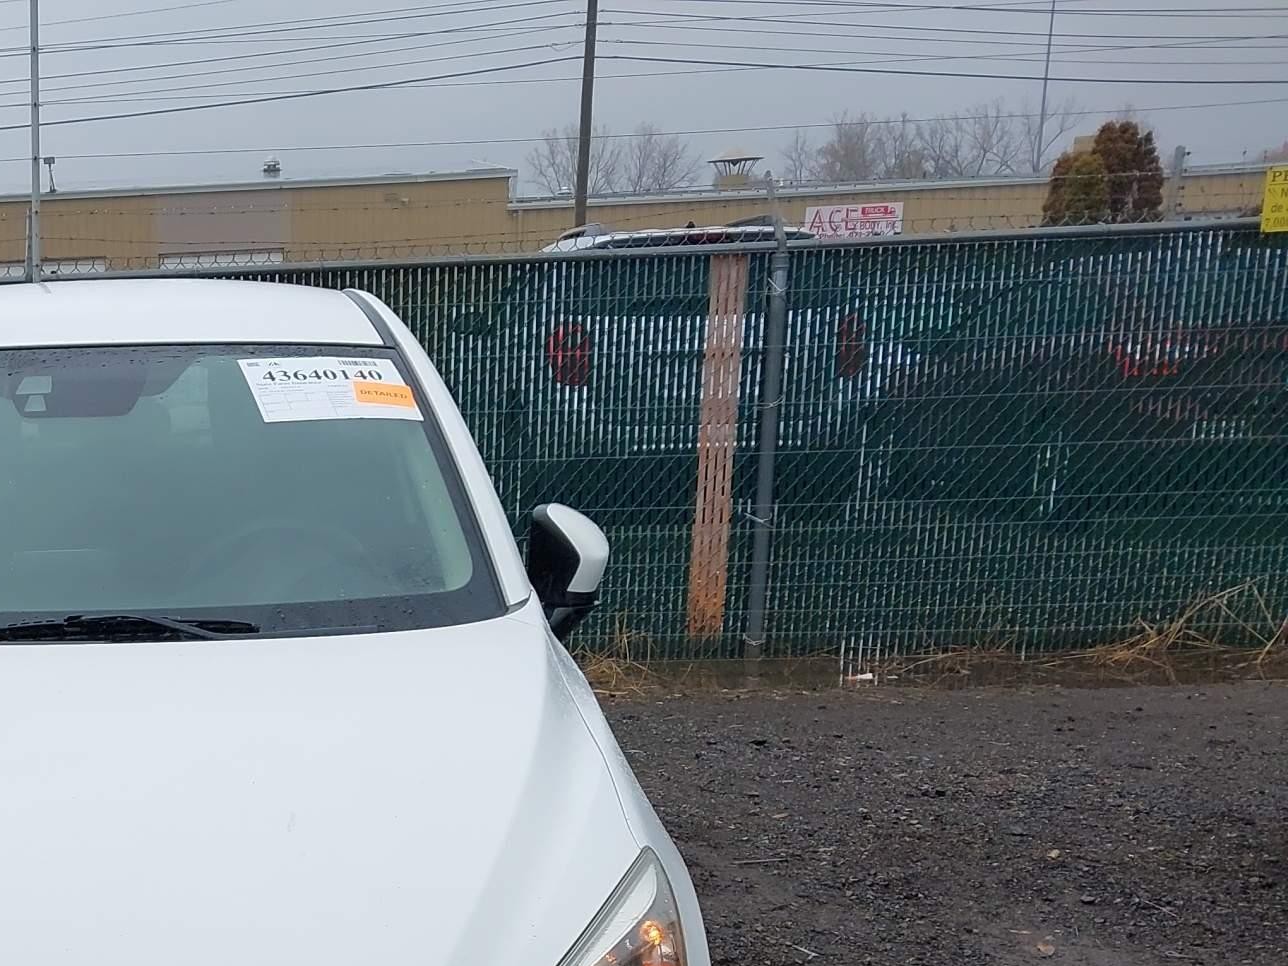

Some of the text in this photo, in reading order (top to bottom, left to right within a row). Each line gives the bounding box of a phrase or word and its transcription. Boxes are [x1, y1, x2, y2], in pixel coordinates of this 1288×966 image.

[809, 207, 858, 233] ACE
[263, 368, 383, 382] 43640140
[360, 389, 408, 399] DETAILED
